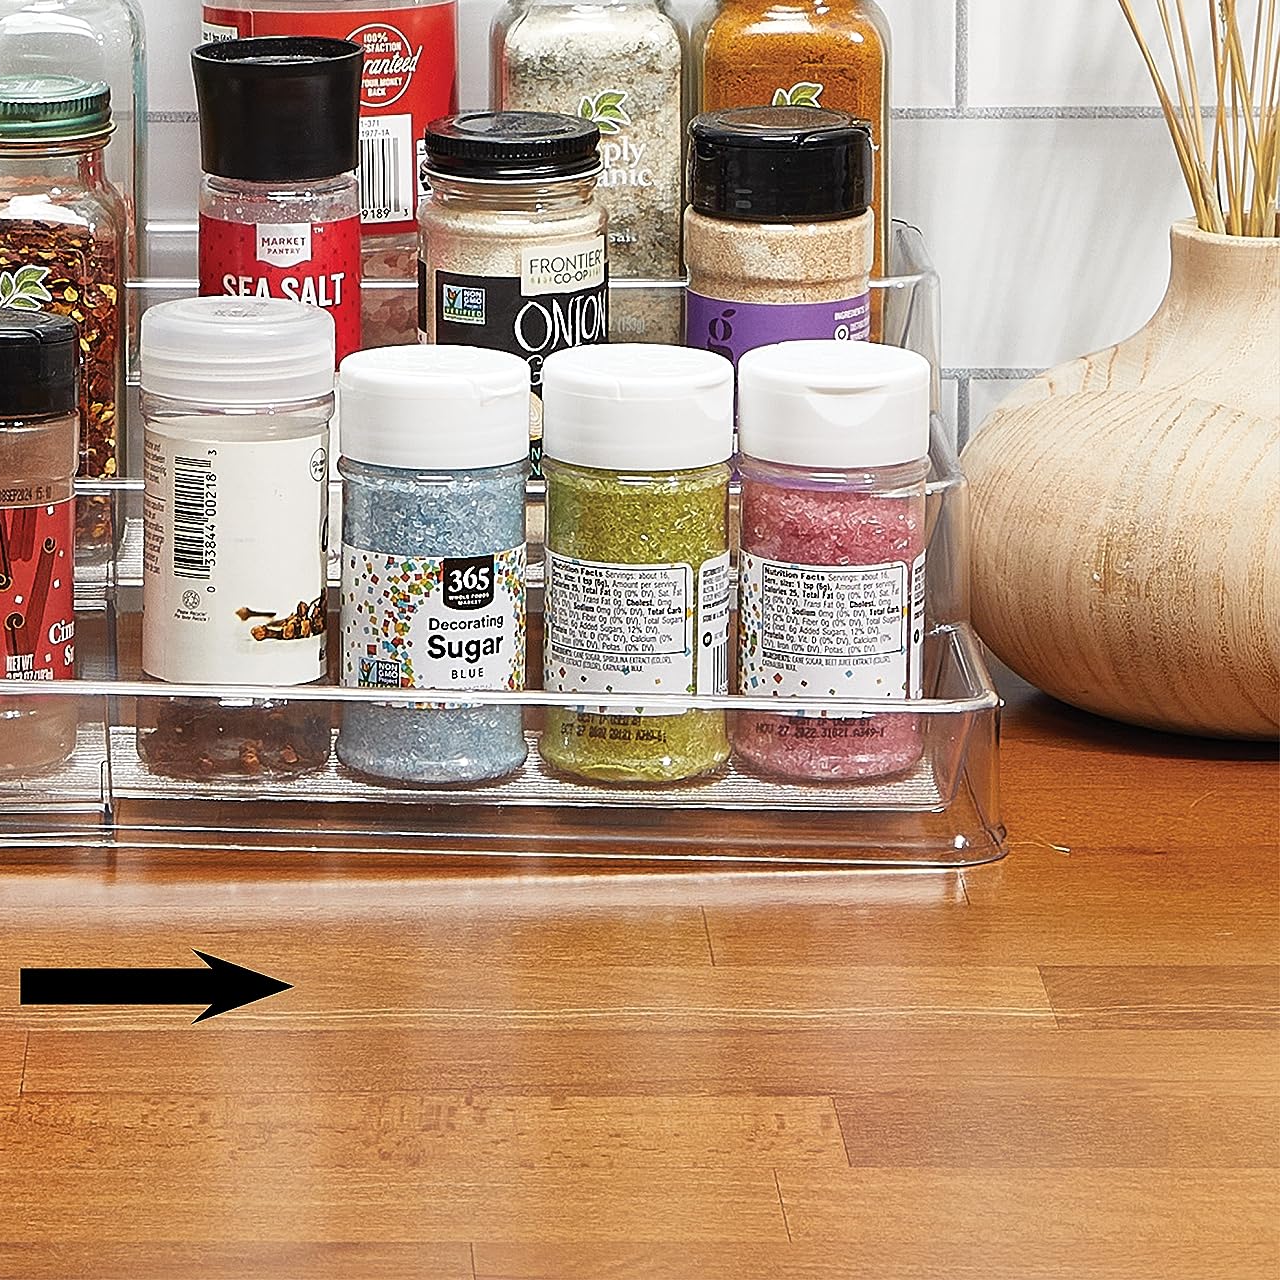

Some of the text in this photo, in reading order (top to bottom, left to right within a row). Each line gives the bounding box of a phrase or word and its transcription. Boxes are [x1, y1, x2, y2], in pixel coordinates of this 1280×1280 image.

[363, 45, 422, 75] ranteed
[260, 237, 306, 249] MARKET
[266, 248, 301, 256] PANTRY
[529, 249, 602, 275] FRONTIER
[553, 270, 588, 285] CO-OP
[222, 272, 345, 307] SEA SALT
[463, 290, 482, 299] NON
[514, 289, 608, 352] ONION
[204, 473, 217, 517] 00218
[204, 524, 217, 567] 33844
[448, 566, 491, 593] 365
[580, 567, 604, 578] Facts
[764, 566, 798, 579] Nutrition
[800, 570, 825, 581] Facts
[861, 572, 880, 582] about
[612, 579, 640, 590] Amount
[834, 581, 874, 592] Amount per
[448, 592, 491, 603] WHOLE FOODS
[802, 588, 833, 599] Total Fat
[457, 600, 482, 608] MARKET
[428, 614, 504, 631] Decorating
[427, 634, 504, 664] Sugar
[451, 667, 484, 680] BLUE
